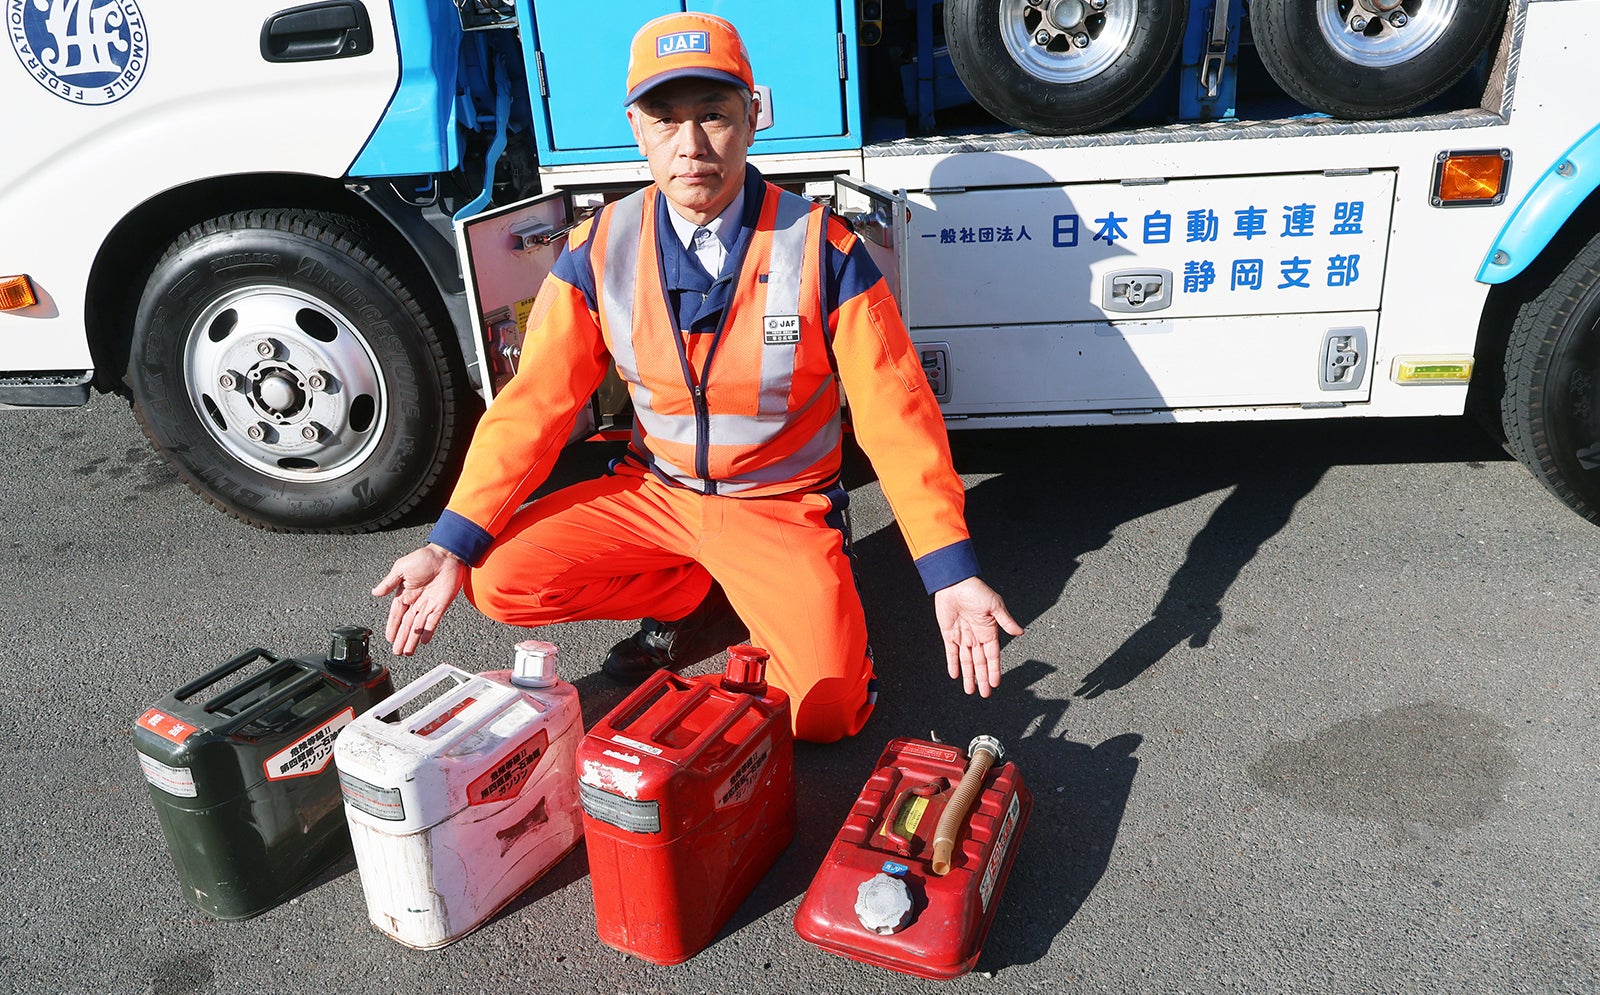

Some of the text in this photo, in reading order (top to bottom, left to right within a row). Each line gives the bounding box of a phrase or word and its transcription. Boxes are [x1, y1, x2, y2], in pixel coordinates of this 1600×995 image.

[103, 0, 144, 99] UTOMOBILE
[663, 34, 700, 52] JAF
[921, 201, 1365, 248] 一般社団法人 日本自動車連盟
[1183, 254, 1361, 293] 静岡支部
[294, 255, 421, 418] BRIDGESTONE
[780, 320, 796, 328] JAF
[299, 746, 333, 772] ガソリン
[498, 768, 529, 797] ガソリン
